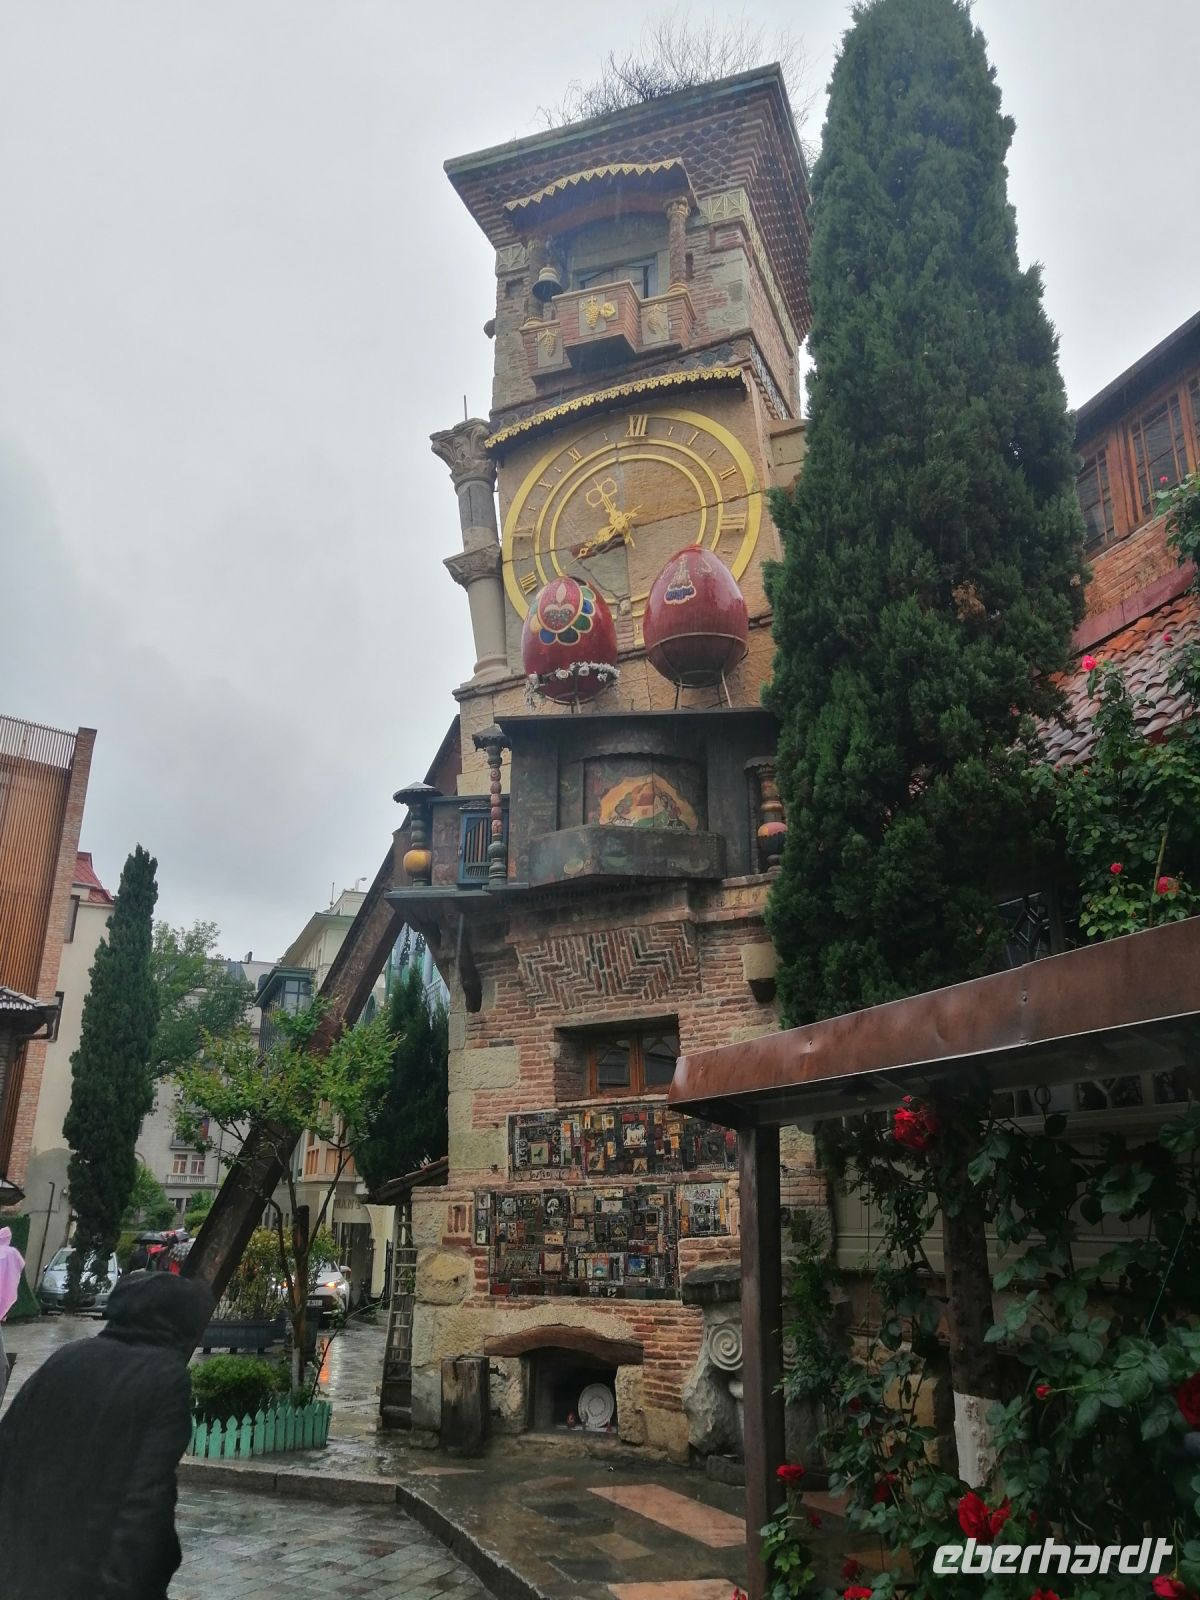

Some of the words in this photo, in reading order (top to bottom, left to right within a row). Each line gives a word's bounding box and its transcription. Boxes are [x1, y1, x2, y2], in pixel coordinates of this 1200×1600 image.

[624, 414, 649, 437] XII
[567, 447, 583, 463] XI
[719, 465, 737, 480] II
